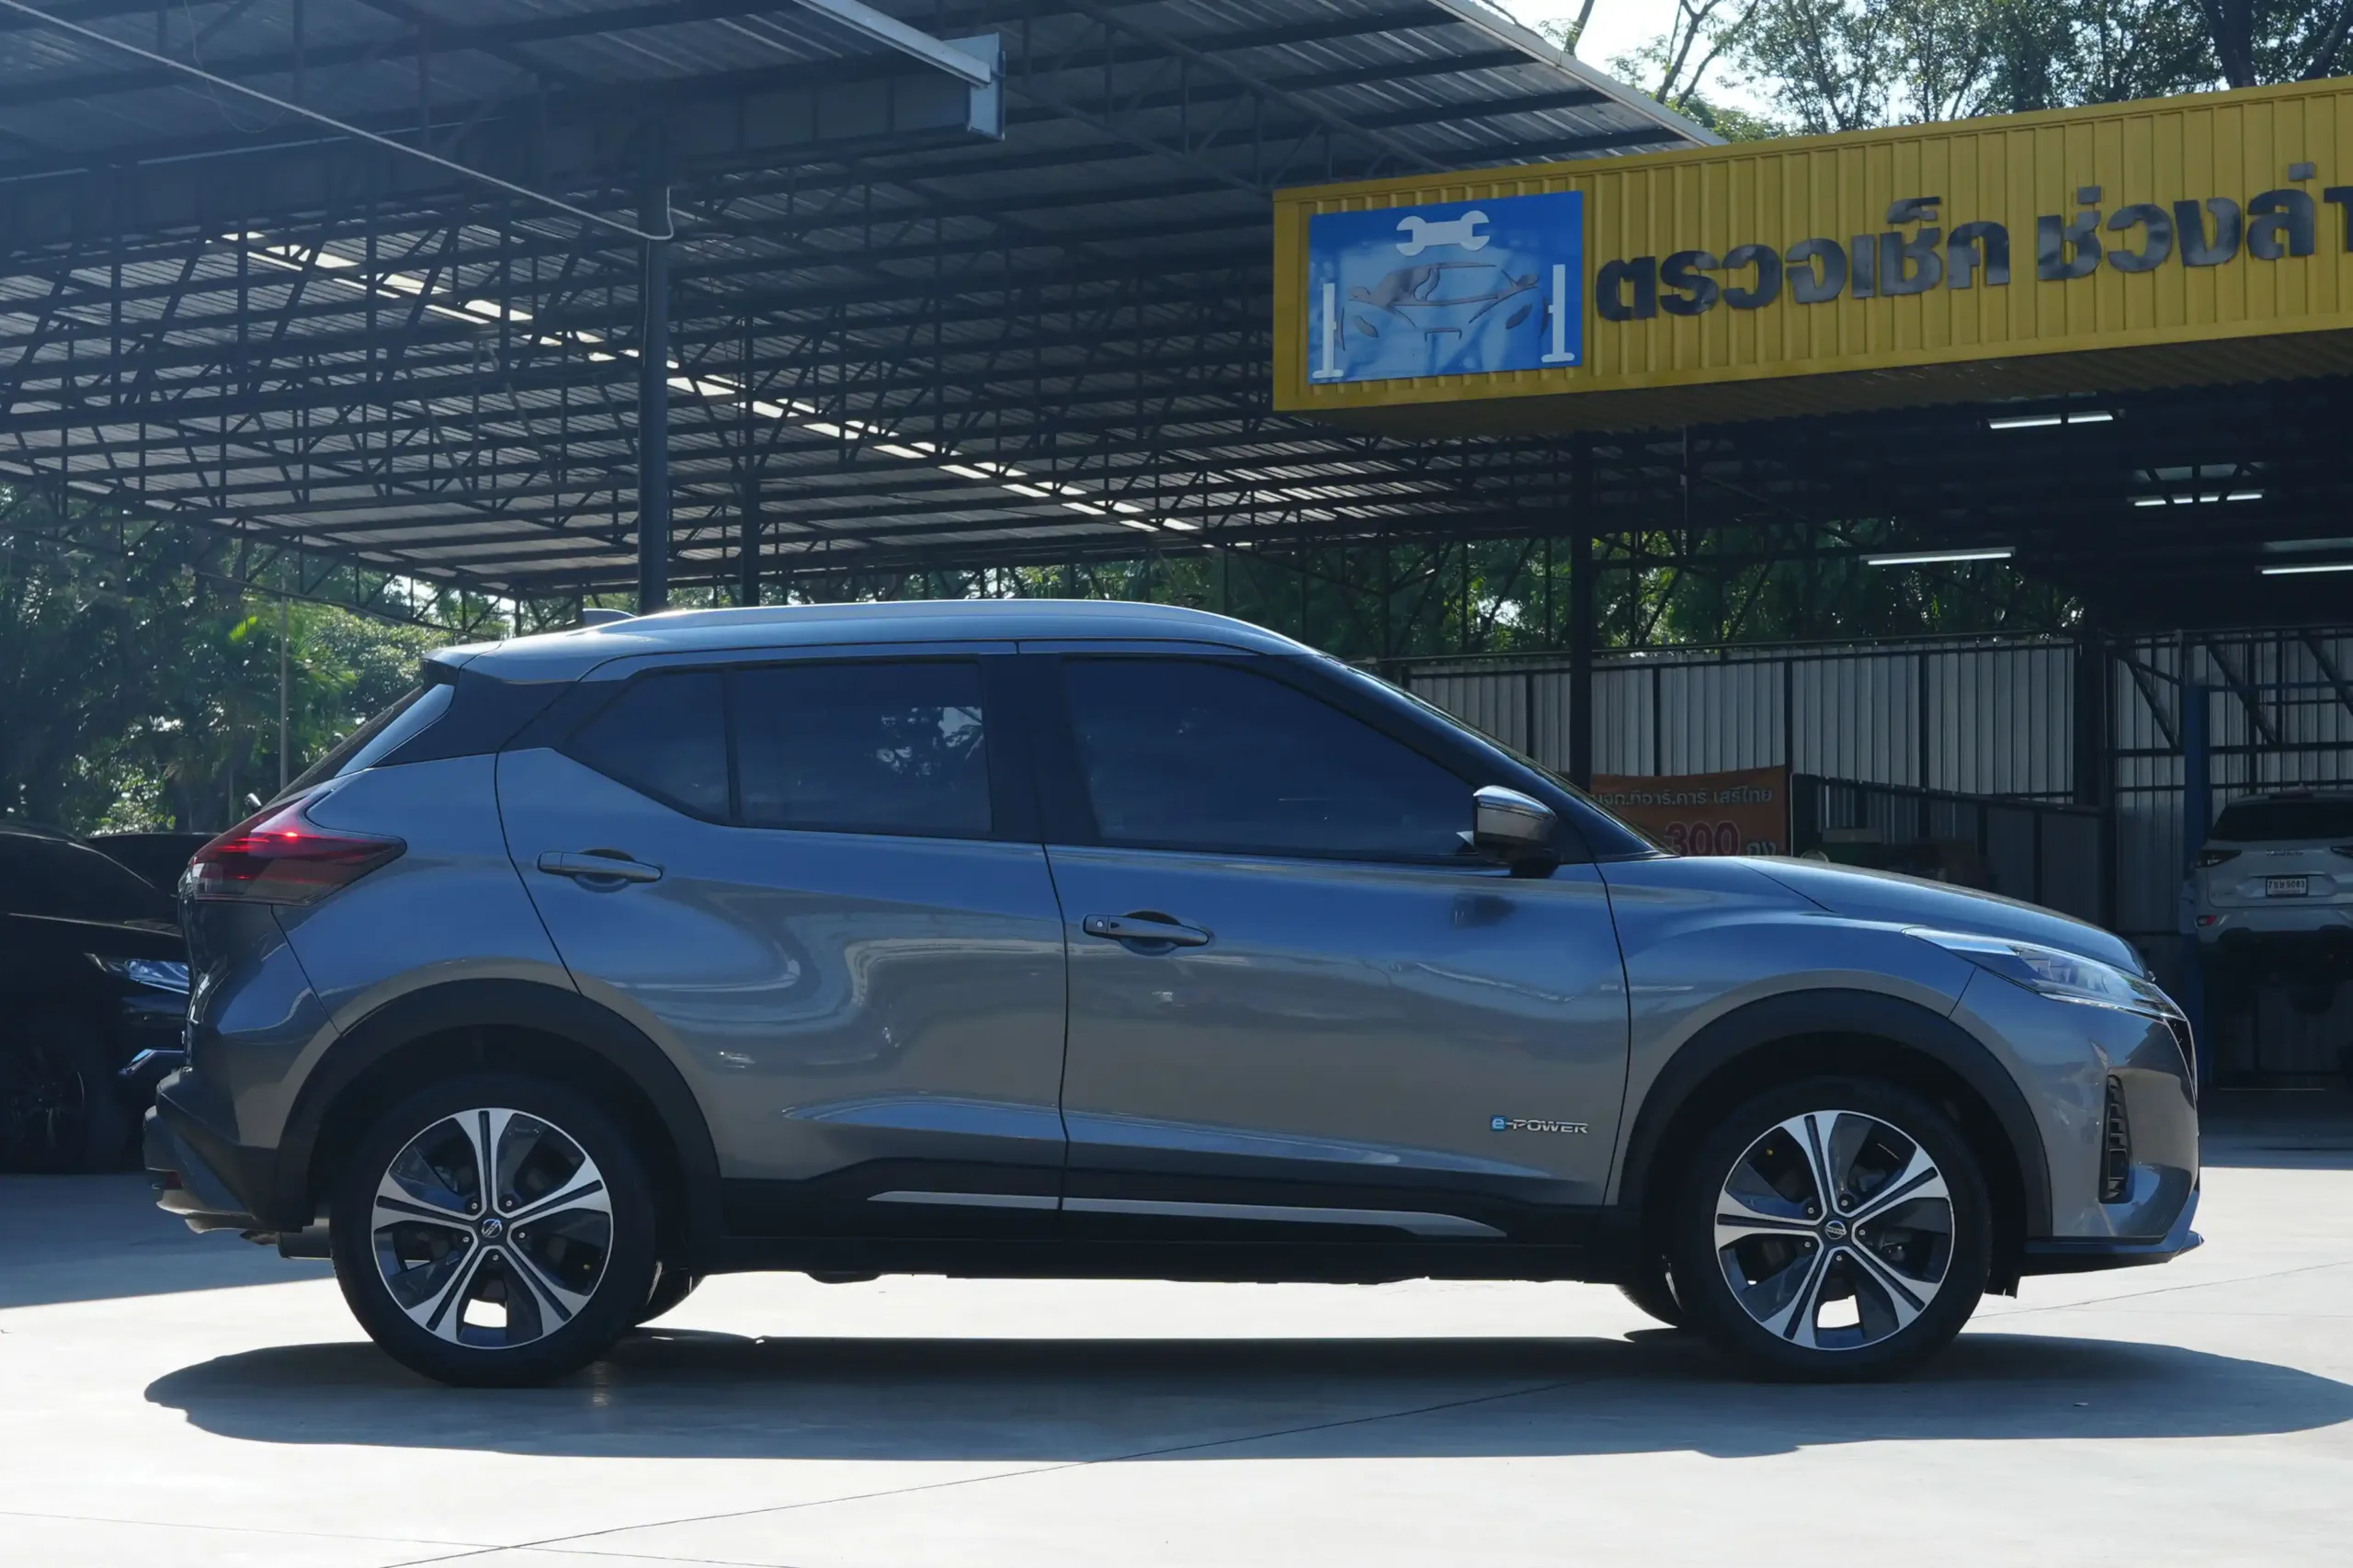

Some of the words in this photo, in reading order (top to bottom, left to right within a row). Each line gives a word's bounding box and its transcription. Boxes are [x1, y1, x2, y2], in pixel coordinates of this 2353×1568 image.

[1596, 197, 2011, 322] ตรวจเช็ค
[1664, 821, 1740, 857] 300
[1491, 1116, 1588, 1134] e-POWER
